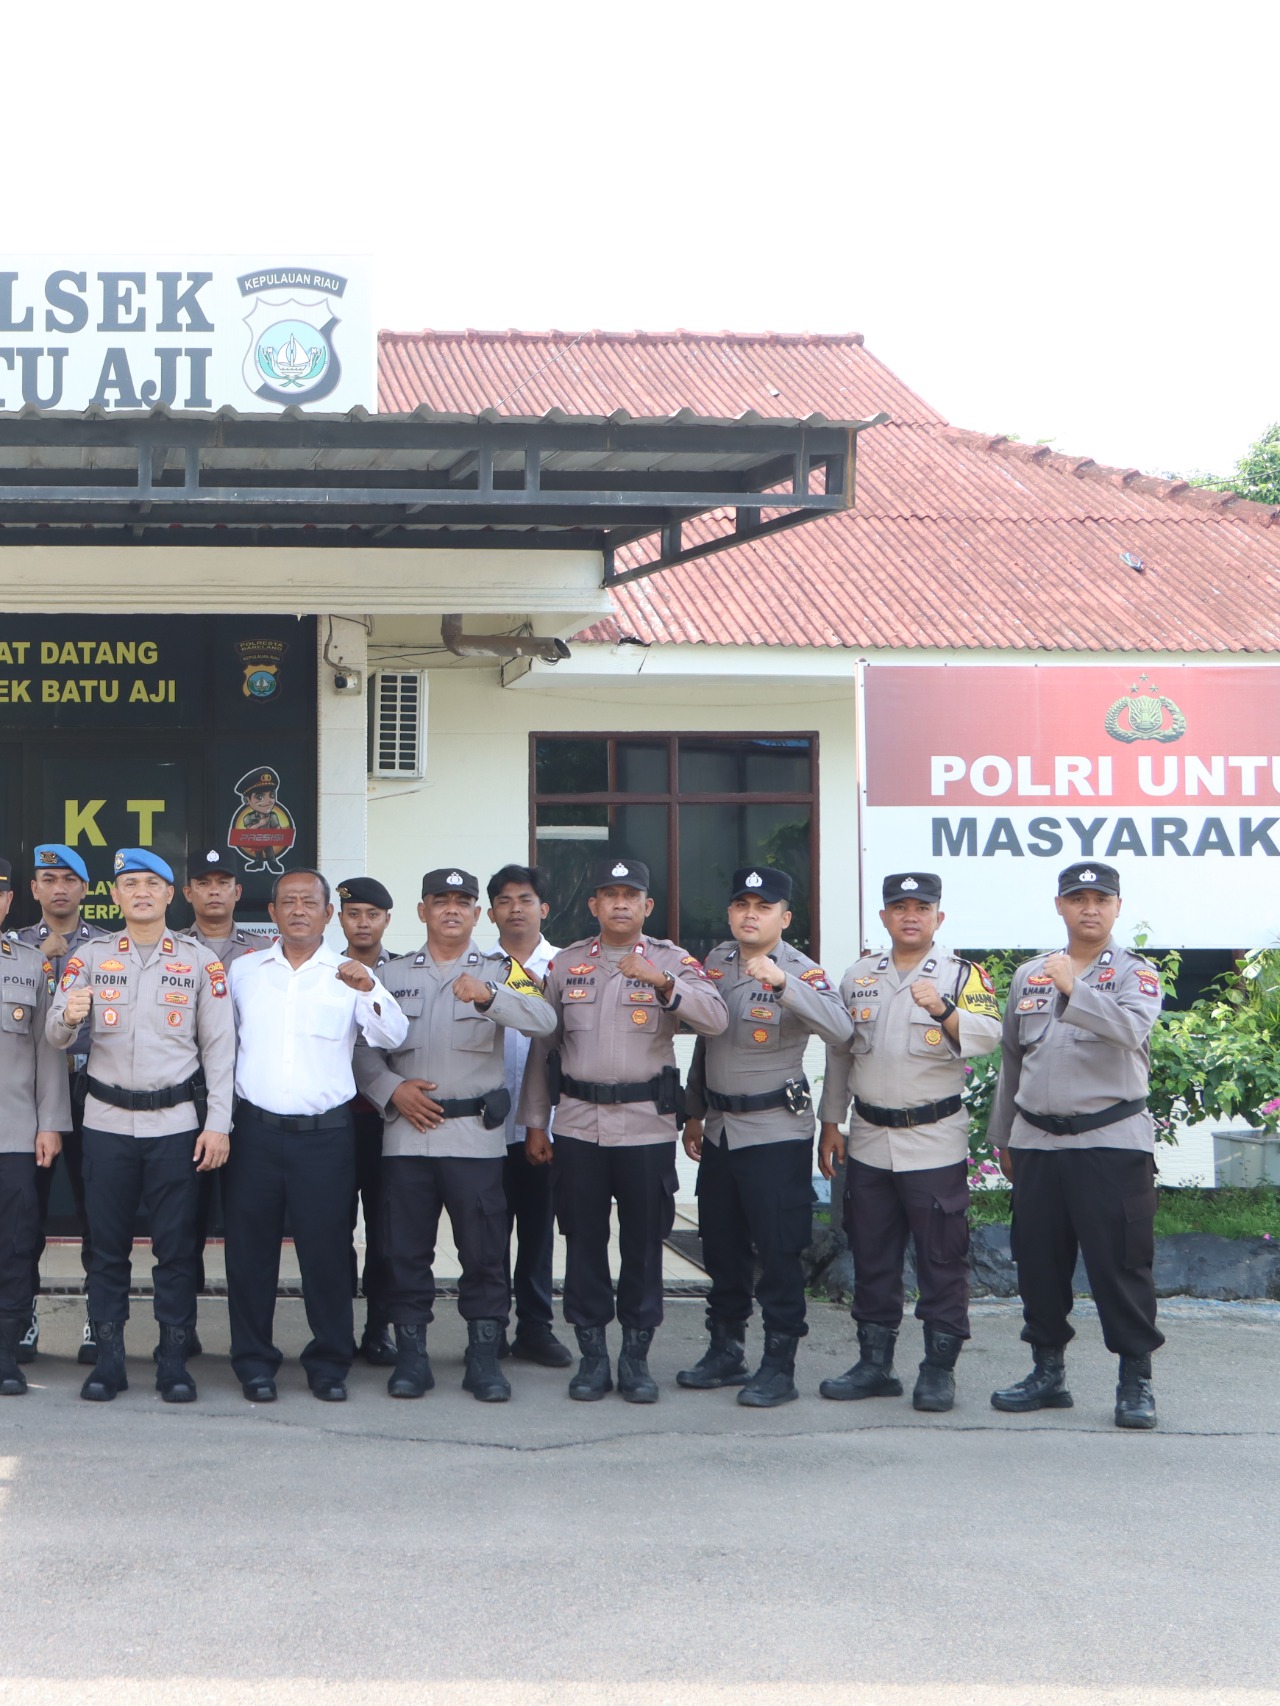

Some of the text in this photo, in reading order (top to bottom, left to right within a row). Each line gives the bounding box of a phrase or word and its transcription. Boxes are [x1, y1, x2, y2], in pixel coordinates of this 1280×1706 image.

[244, 273, 340, 291] KEPULAUAN RIAU
[88, 347, 214, 408] AJI
[40, 641, 159, 665] DATANG
[41, 680, 119, 703] BATU
[128, 680, 176, 703] AJI
[930, 755, 1280, 796] POLRI UNT
[240, 833, 284, 842] PRESISI
[3, 976, 36, 988] POLRI
[94, 974, 128, 986] ROBIN
[161, 975, 195, 989] POLRI
[850, 989, 879, 999] AGUS
